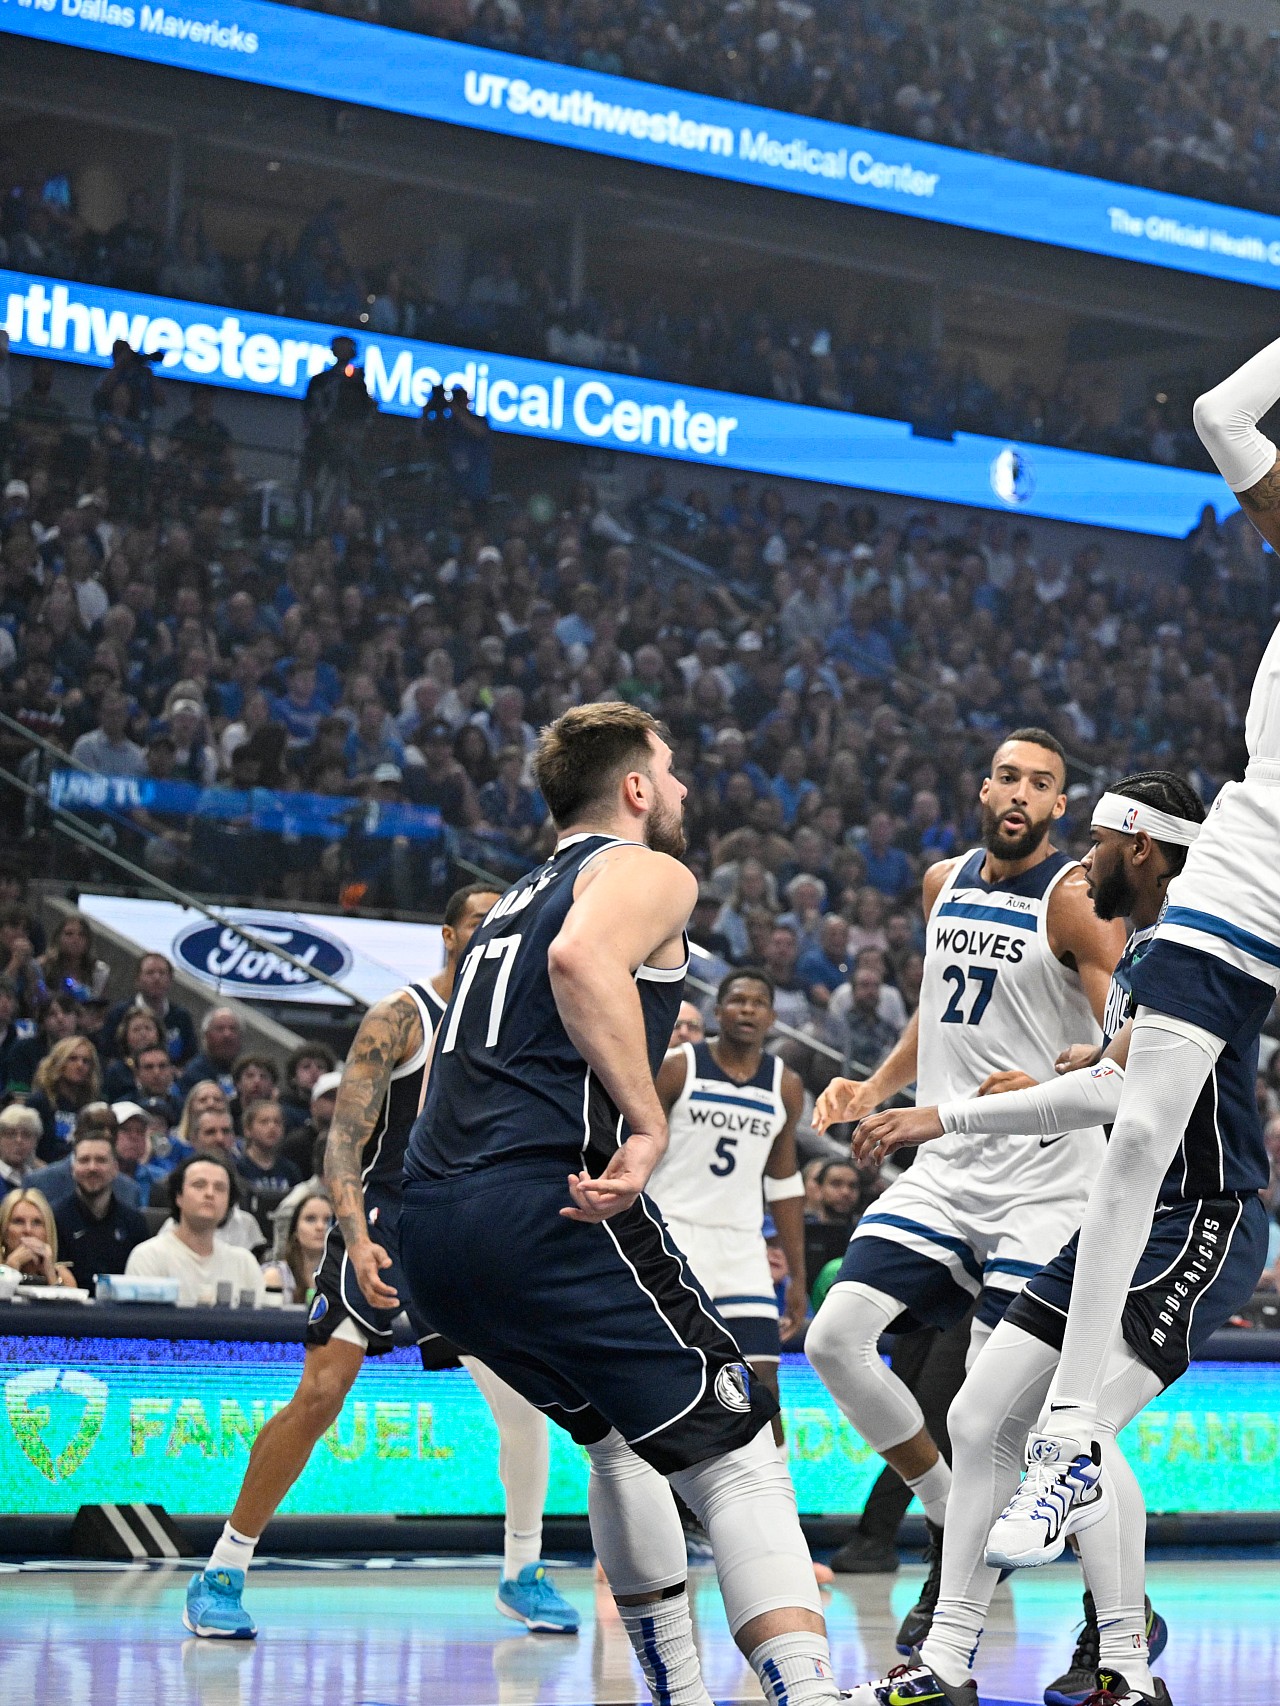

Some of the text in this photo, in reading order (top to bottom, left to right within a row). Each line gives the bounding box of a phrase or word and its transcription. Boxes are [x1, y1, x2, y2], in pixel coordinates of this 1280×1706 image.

[139, 5, 259, 53] Mavericks
[464, 69, 940, 197] UTSouthwestern Medical Center
[1106, 206, 1144, 237] The
[1144, 215, 1209, 251] Official
[1208, 227, 1267, 263] Health
[572, 380, 739, 456] Center
[206, 924, 320, 983] Ford
[936, 927, 1026, 964] WOLVES
[441, 932, 523, 1055] 77
[940, 964, 998, 1026] 27
[689, 1107, 772, 1138] WOLVES
[709, 1135, 739, 1178] 5
[1151, 1218, 1220, 1348] MAVERICKS
[130, 1398, 455, 1462] FANUEL
